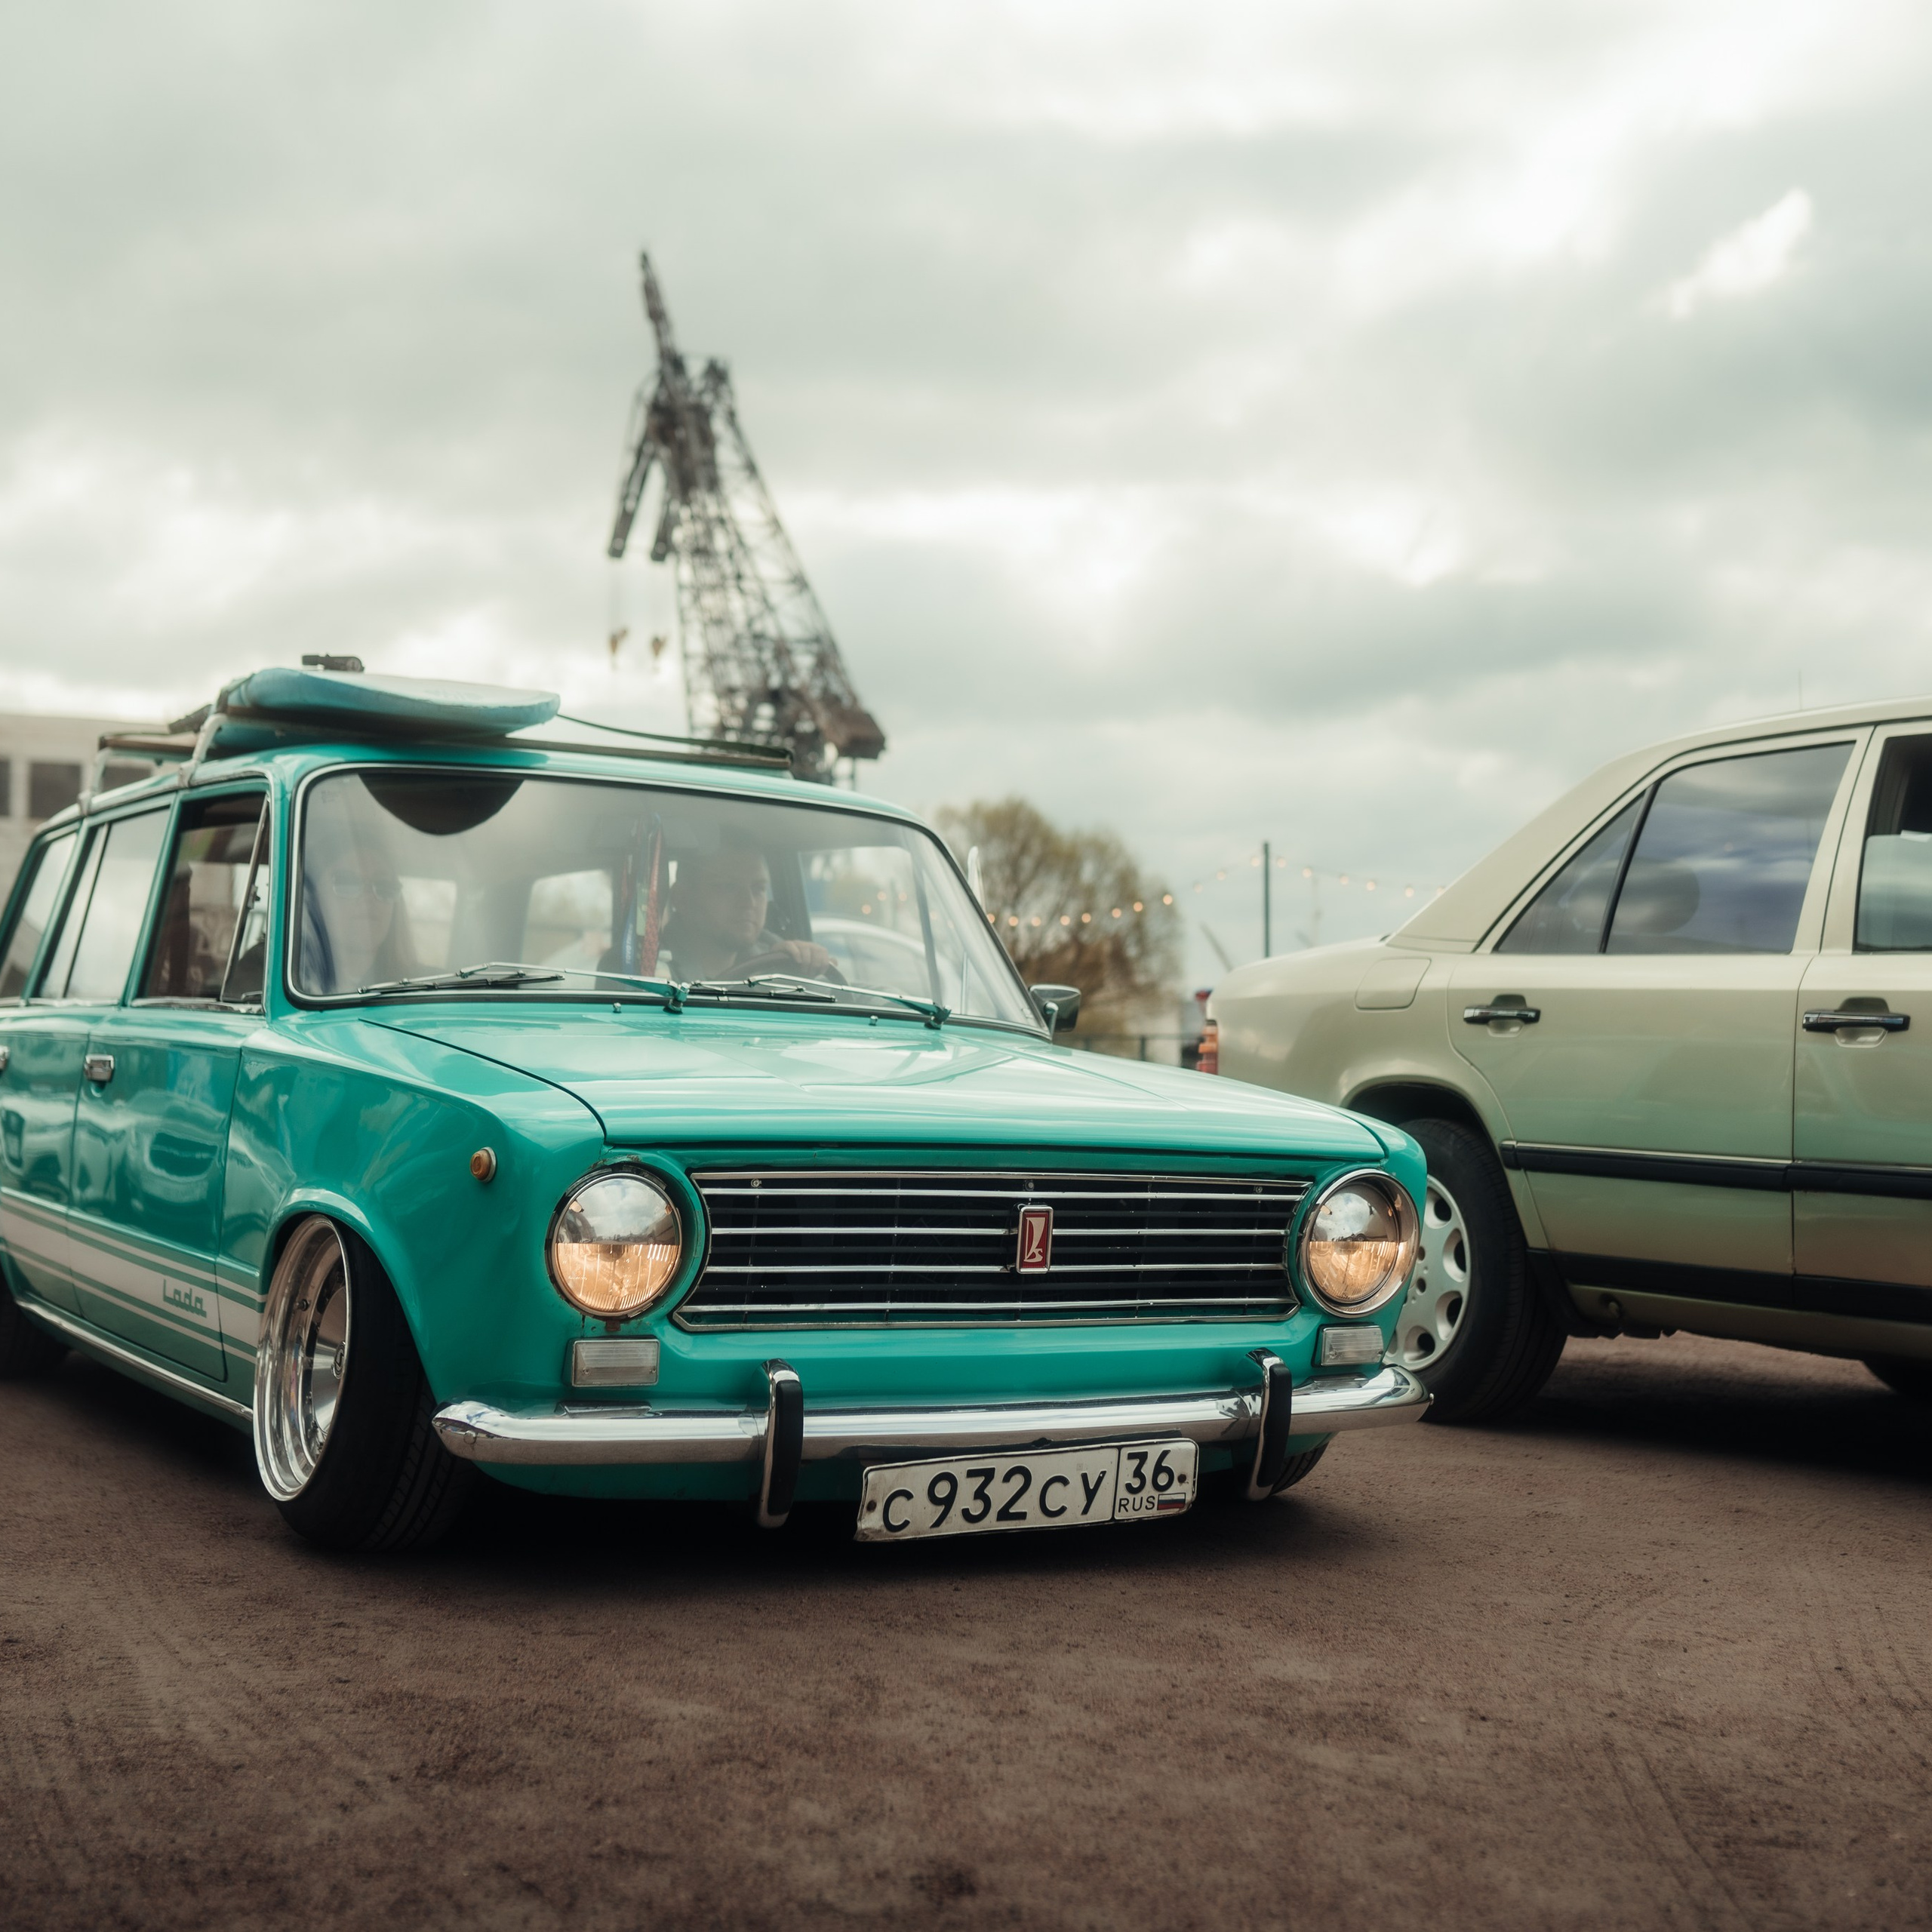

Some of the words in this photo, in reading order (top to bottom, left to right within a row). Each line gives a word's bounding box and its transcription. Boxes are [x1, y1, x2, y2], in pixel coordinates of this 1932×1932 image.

[163, 1278, 207, 1318] Lada
[1125, 1450, 1174, 1494] 36
[1118, 1496, 1155, 1512] RUS
